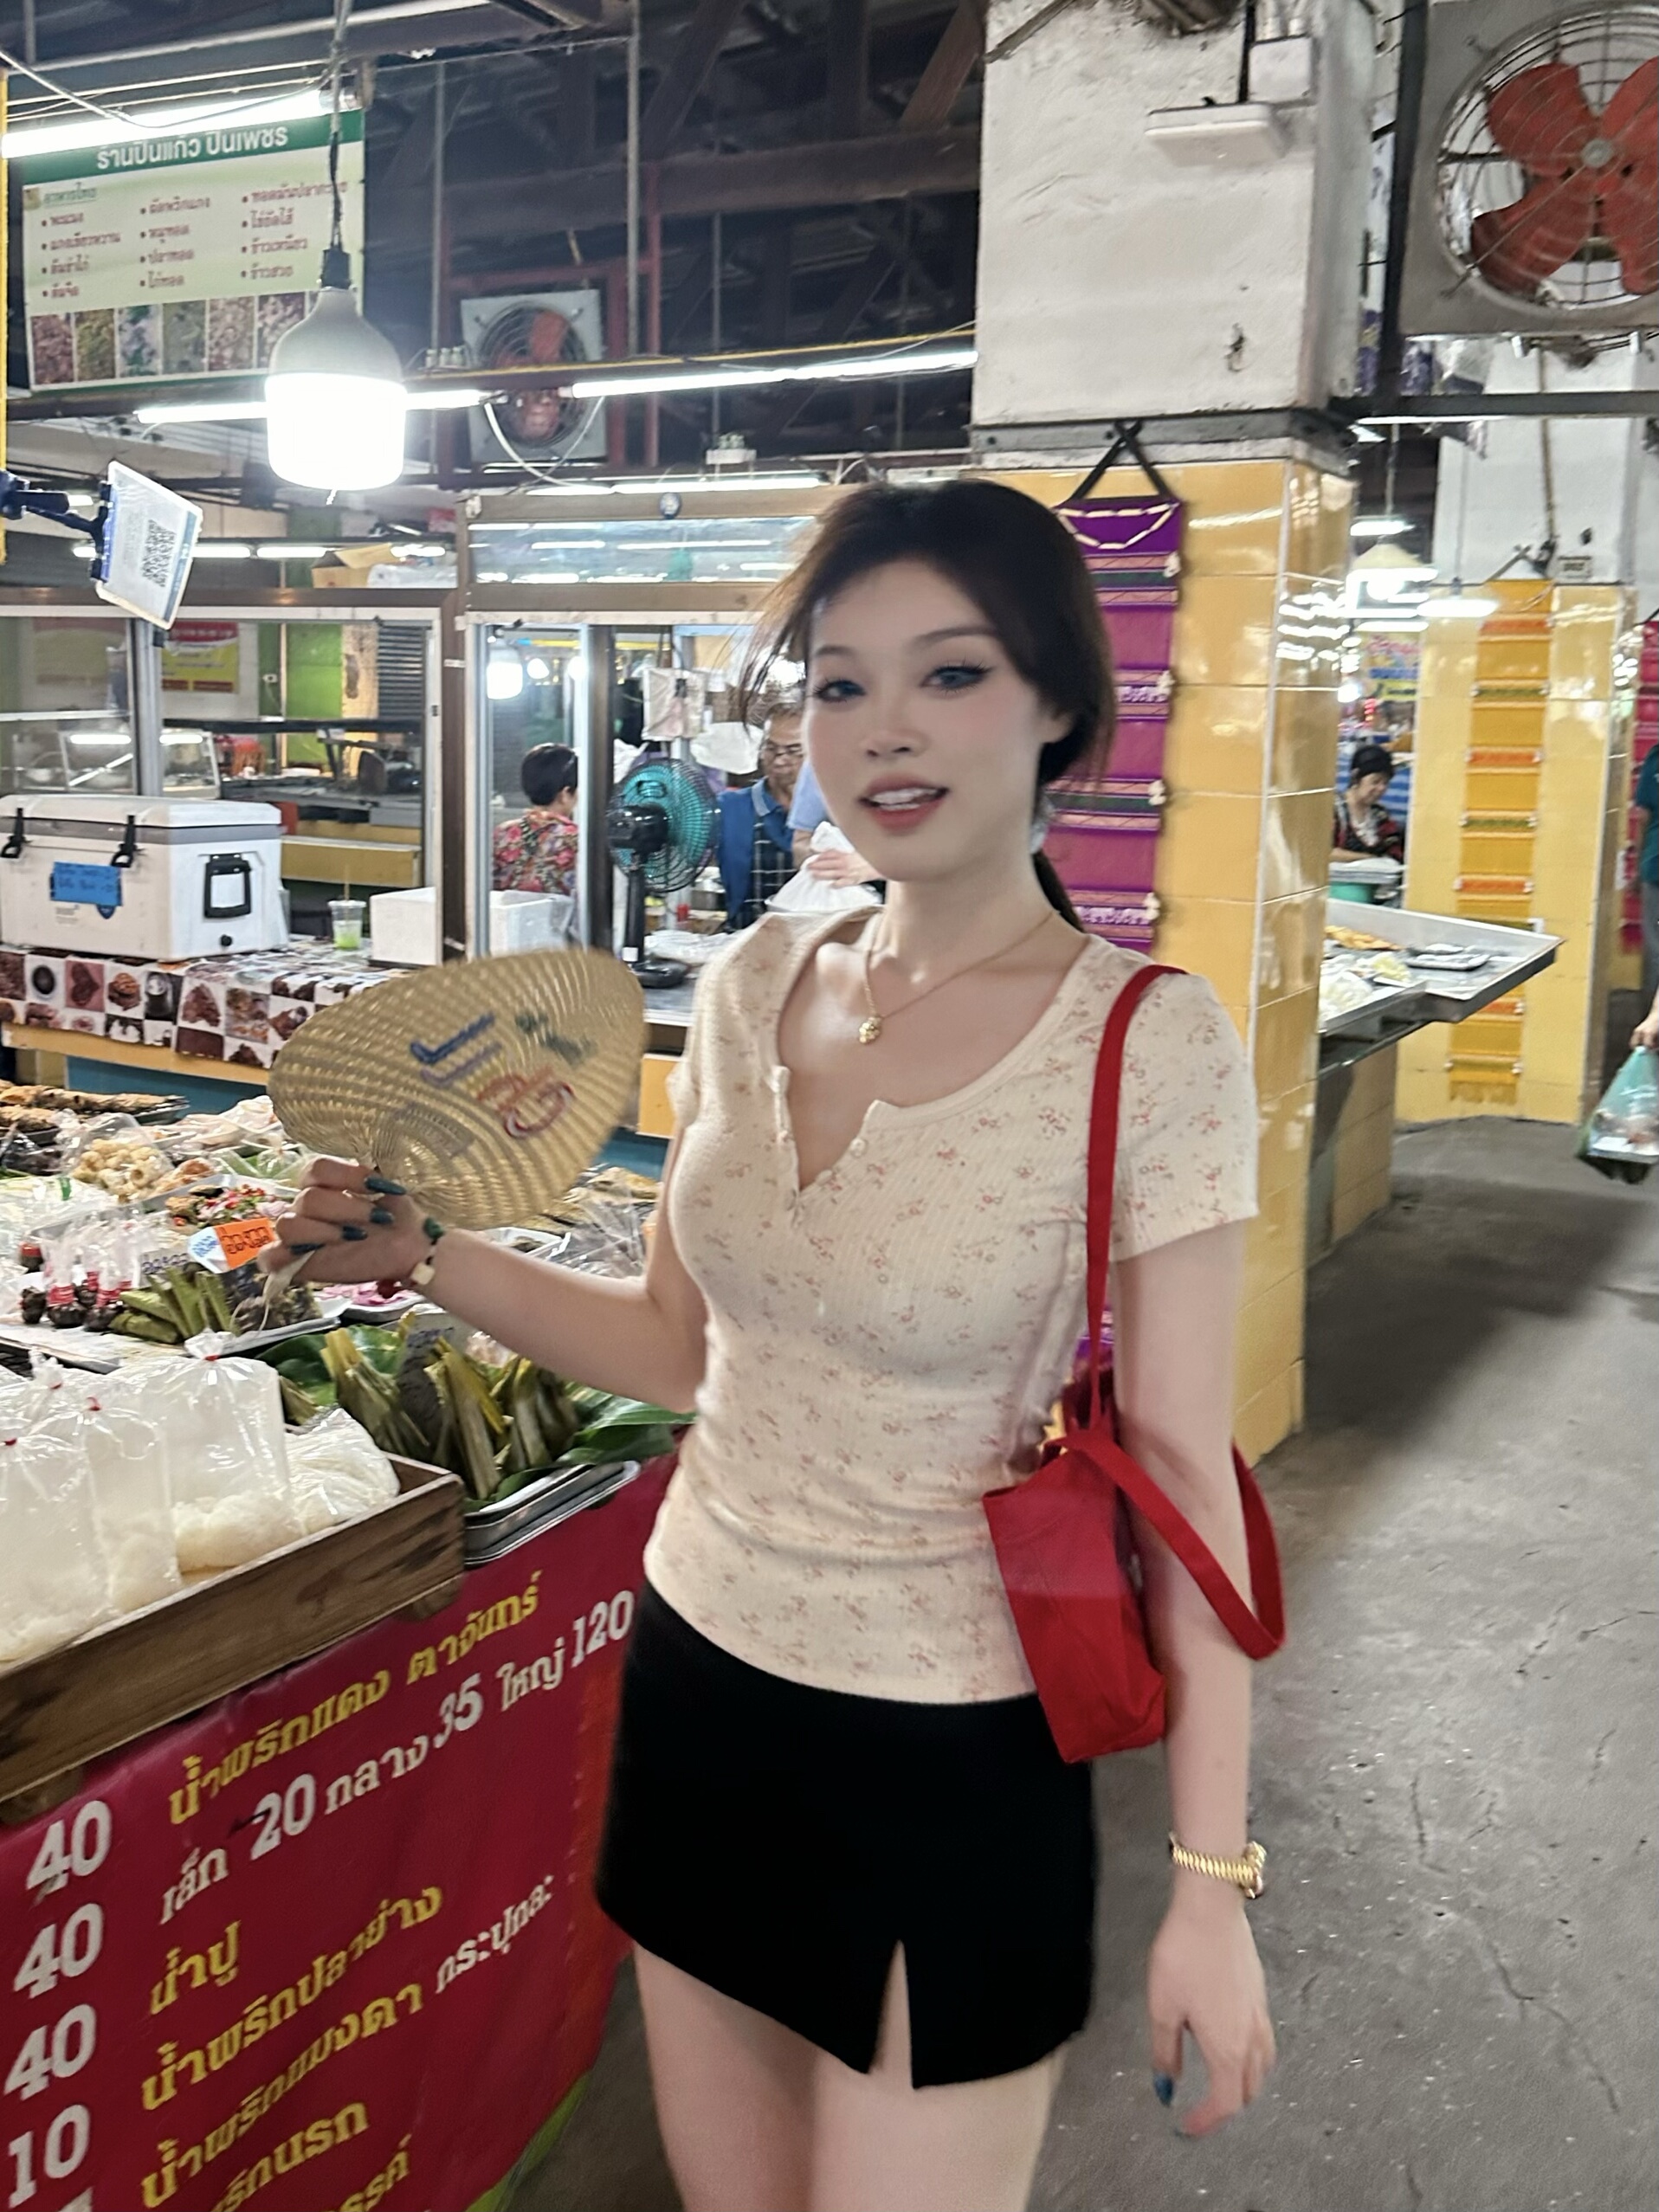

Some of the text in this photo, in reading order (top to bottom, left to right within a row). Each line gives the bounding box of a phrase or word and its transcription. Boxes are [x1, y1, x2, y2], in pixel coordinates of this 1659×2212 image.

[160, 1590, 635, 1925] เล็ก 20 กลาง 35 ใหญ่ 120
[26, 1800, 112, 1893] 40
[13, 1903, 103, 1999] 40
[3, 2003, 96, 2100] 40
[8, 2104, 90, 2209] 10
[211, 2103, 369, 2212] ริกนรก
